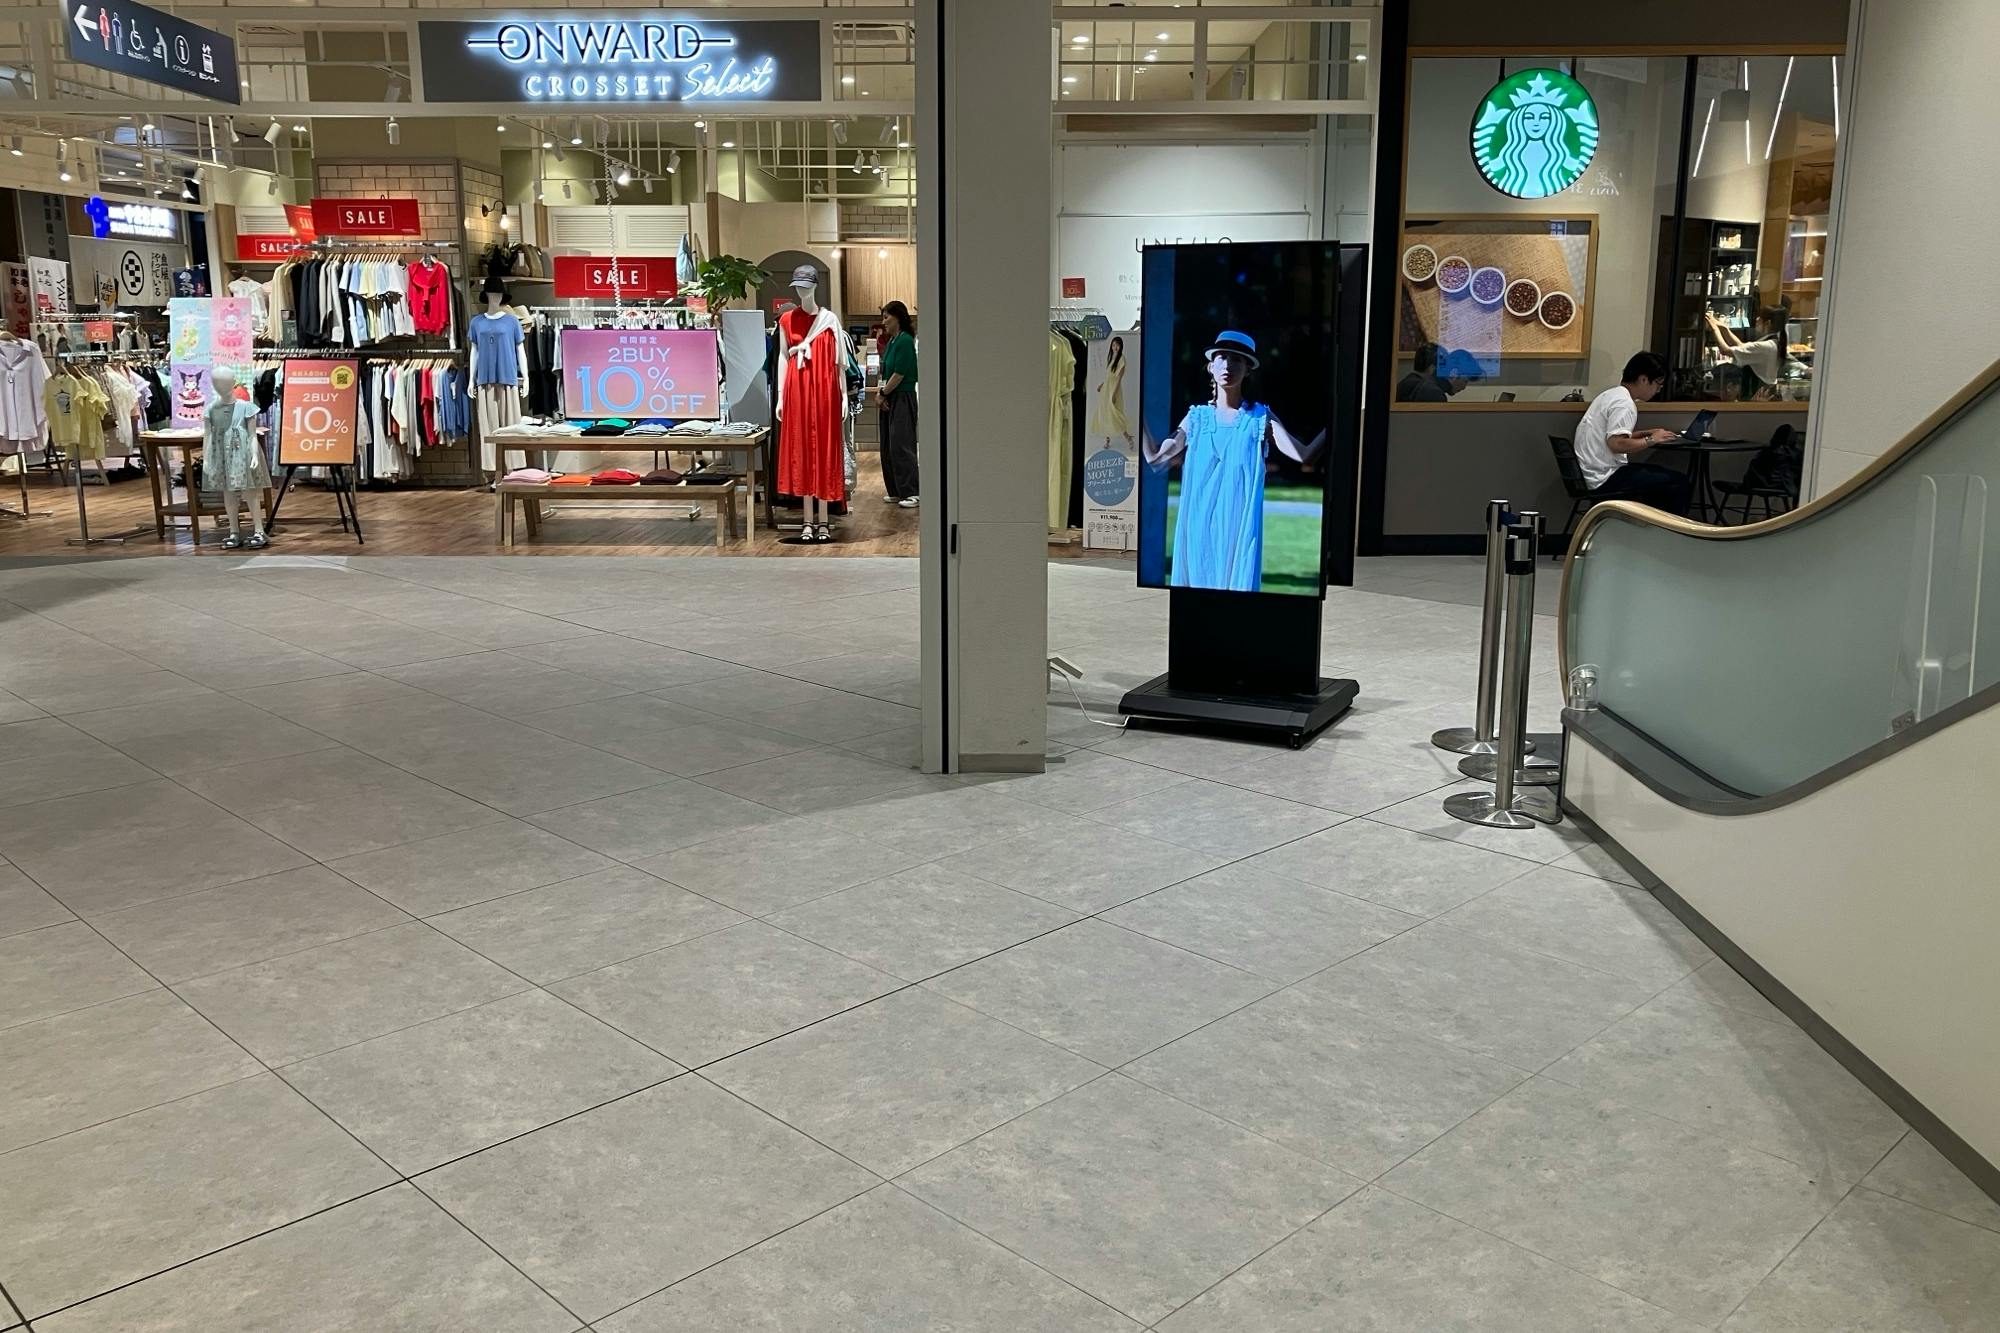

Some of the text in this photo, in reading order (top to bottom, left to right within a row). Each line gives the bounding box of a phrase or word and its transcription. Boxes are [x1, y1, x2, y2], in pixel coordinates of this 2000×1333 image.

[498, 22, 705, 64] ONWARD
[526, 56, 774, 101] CROSSET Select
[299, 217, 313, 230] SAL
[345, 210, 386, 225] SALE
[260, 242, 290, 253] SALE
[593, 269, 639, 285] SALE
[607, 347, 672, 364] 2BUY
[302, 392, 340, 403] 2BUY
[648, 393, 707, 415] OFF
[292, 405, 349, 435] 10%
[300, 438, 337, 452] OFF
[1087, 457, 1124, 471] BREEZE
[1087, 468, 1115, 481] MOVE
